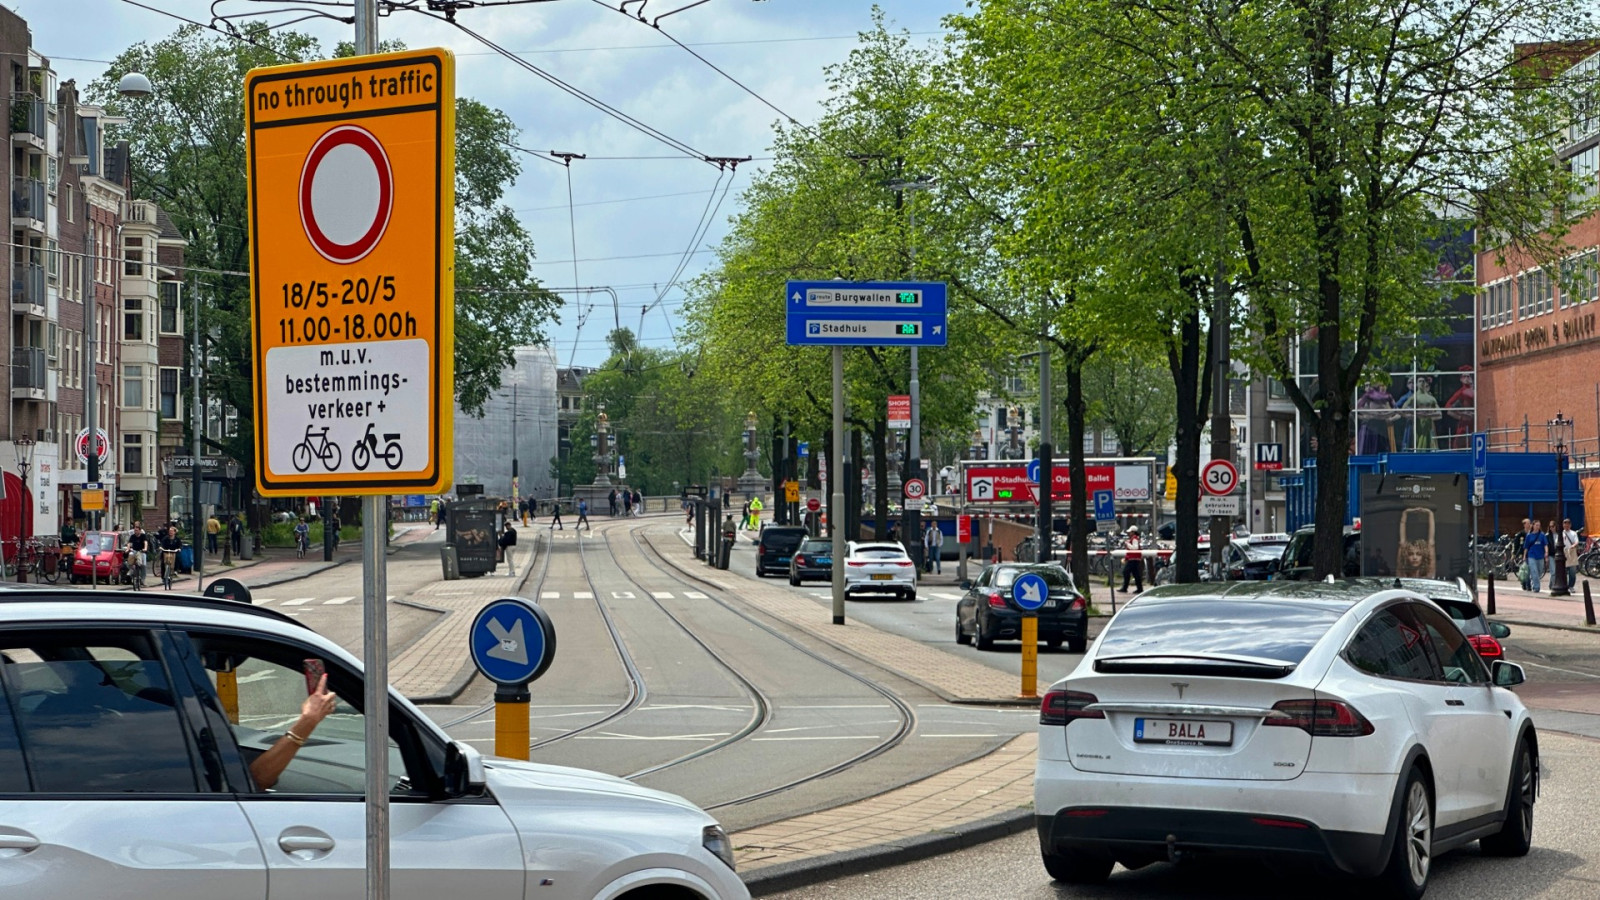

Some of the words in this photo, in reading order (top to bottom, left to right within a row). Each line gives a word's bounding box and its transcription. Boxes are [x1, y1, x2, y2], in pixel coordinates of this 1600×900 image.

[258, 90, 280, 111] no
[285, 76, 363, 109] through
[369, 69, 433, 98] traffic
[282, 275, 396, 310] 18/5-20/5
[835, 292, 891, 304] Burgwallen
[279, 311, 417, 343] 11.00-18.00h
[822, 323, 867, 333] Stadhuis
[320, 348, 372, 366] m.u.v.
[286, 371, 408, 396] bestemmings-
[308, 398, 373, 419] verkeer
[1262, 444, 1279, 462] M
[1208, 470, 1232, 485] 30
[909, 485, 922, 493] 30
[1098, 493, 1110, 510] P
[1168, 722, 1206, 739] BALA
